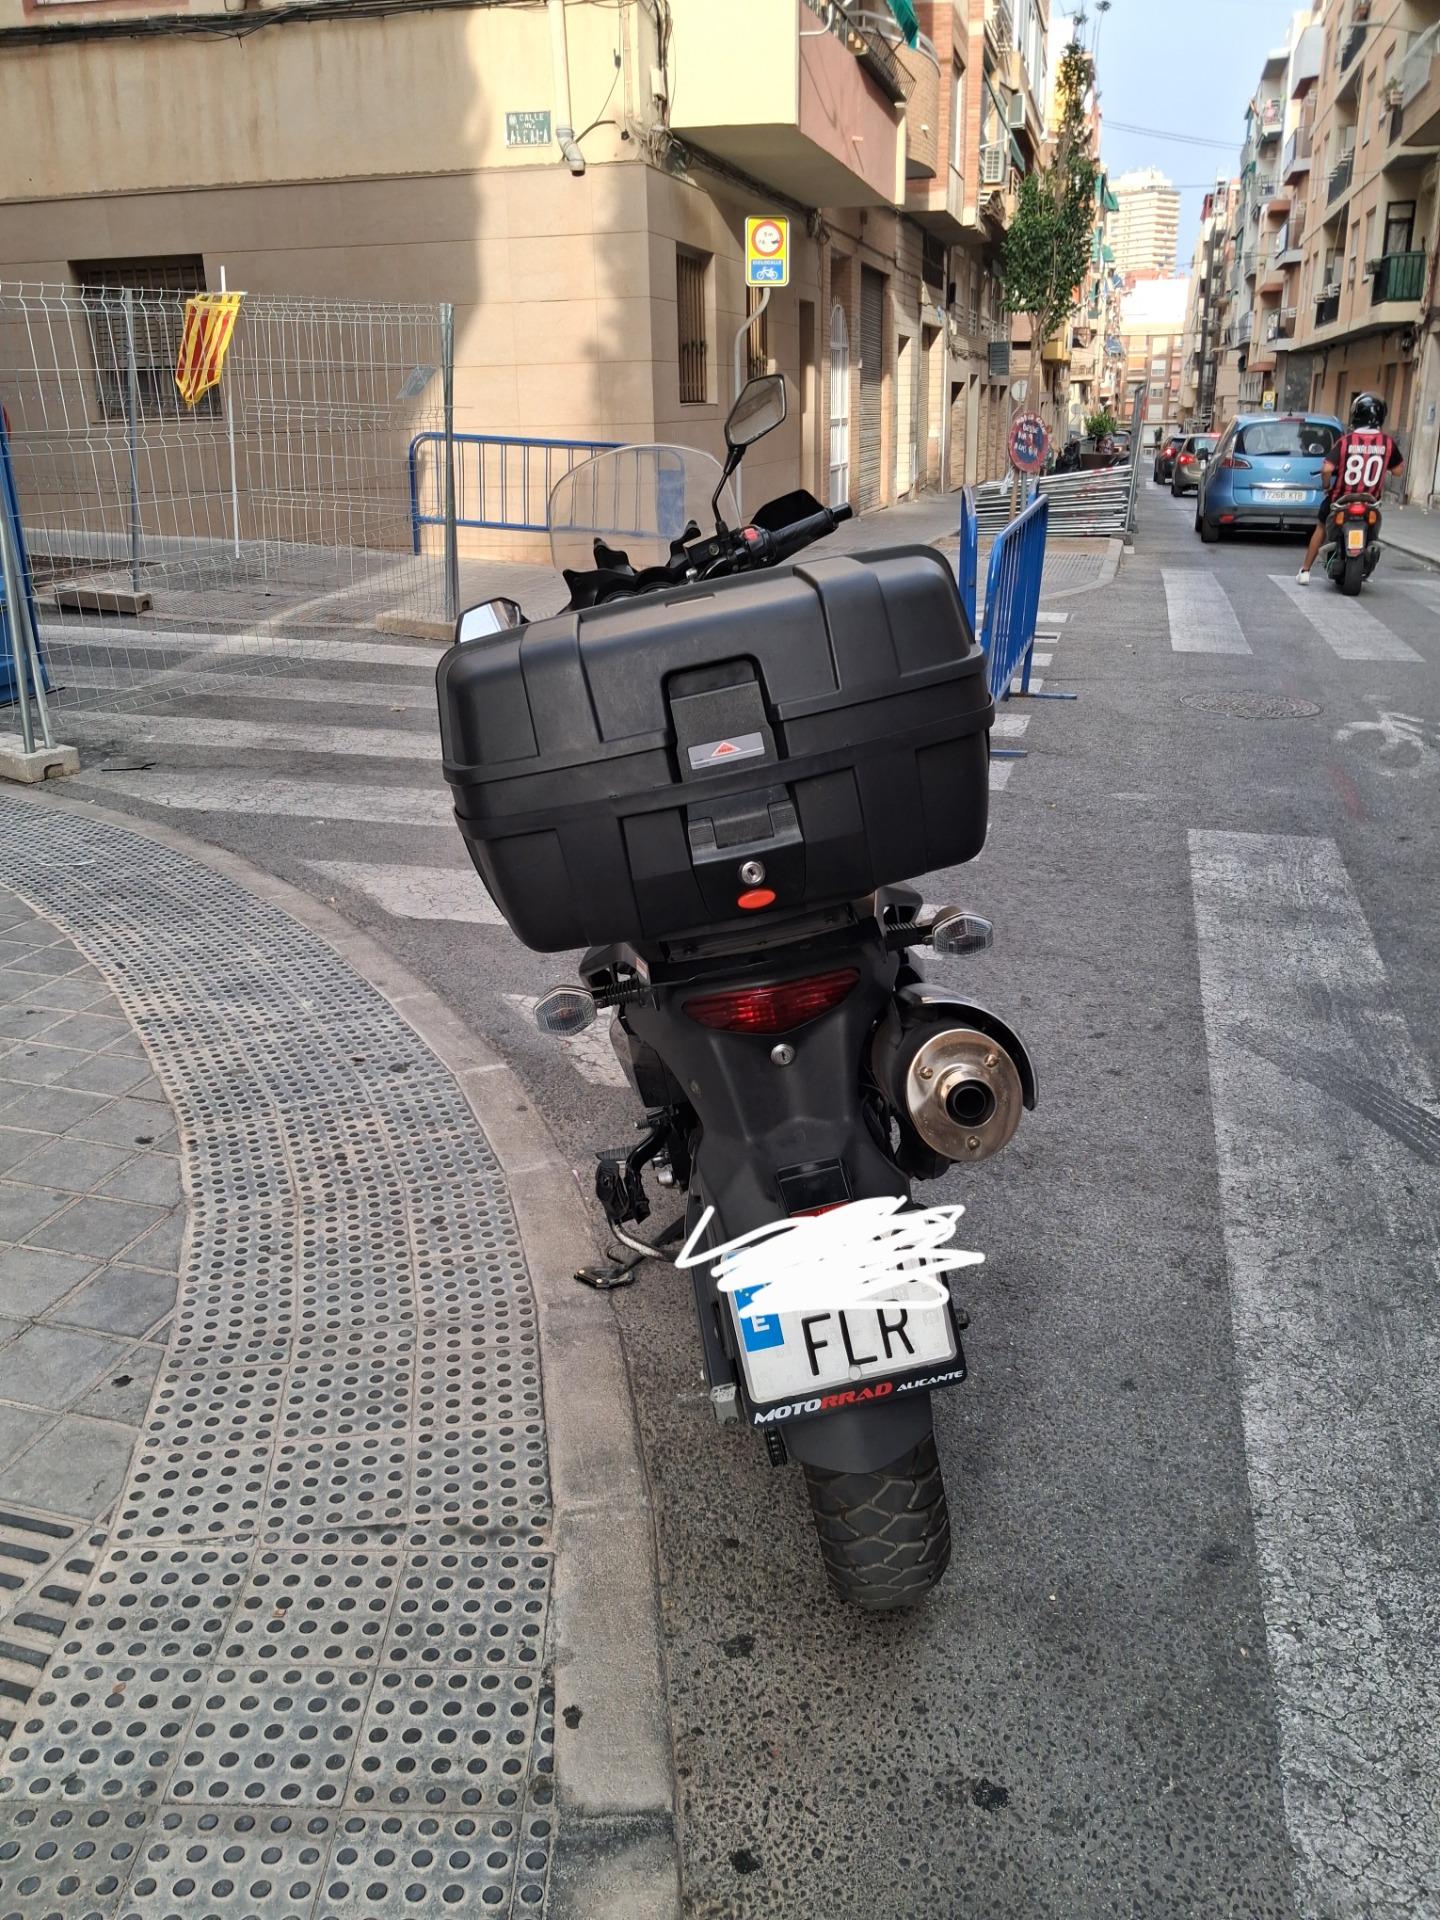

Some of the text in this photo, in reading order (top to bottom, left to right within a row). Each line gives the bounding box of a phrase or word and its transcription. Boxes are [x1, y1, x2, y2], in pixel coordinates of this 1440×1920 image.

[519, 113, 544, 121] CALLE
[1348, 444, 1386, 455] RONALDINHO
[1344, 455, 1384, 487] 80
[751, 1313, 770, 1333] E
[801, 1299, 915, 1375] FLR
[754, 1369, 965, 1425] MOTORRAD ALICANTE
